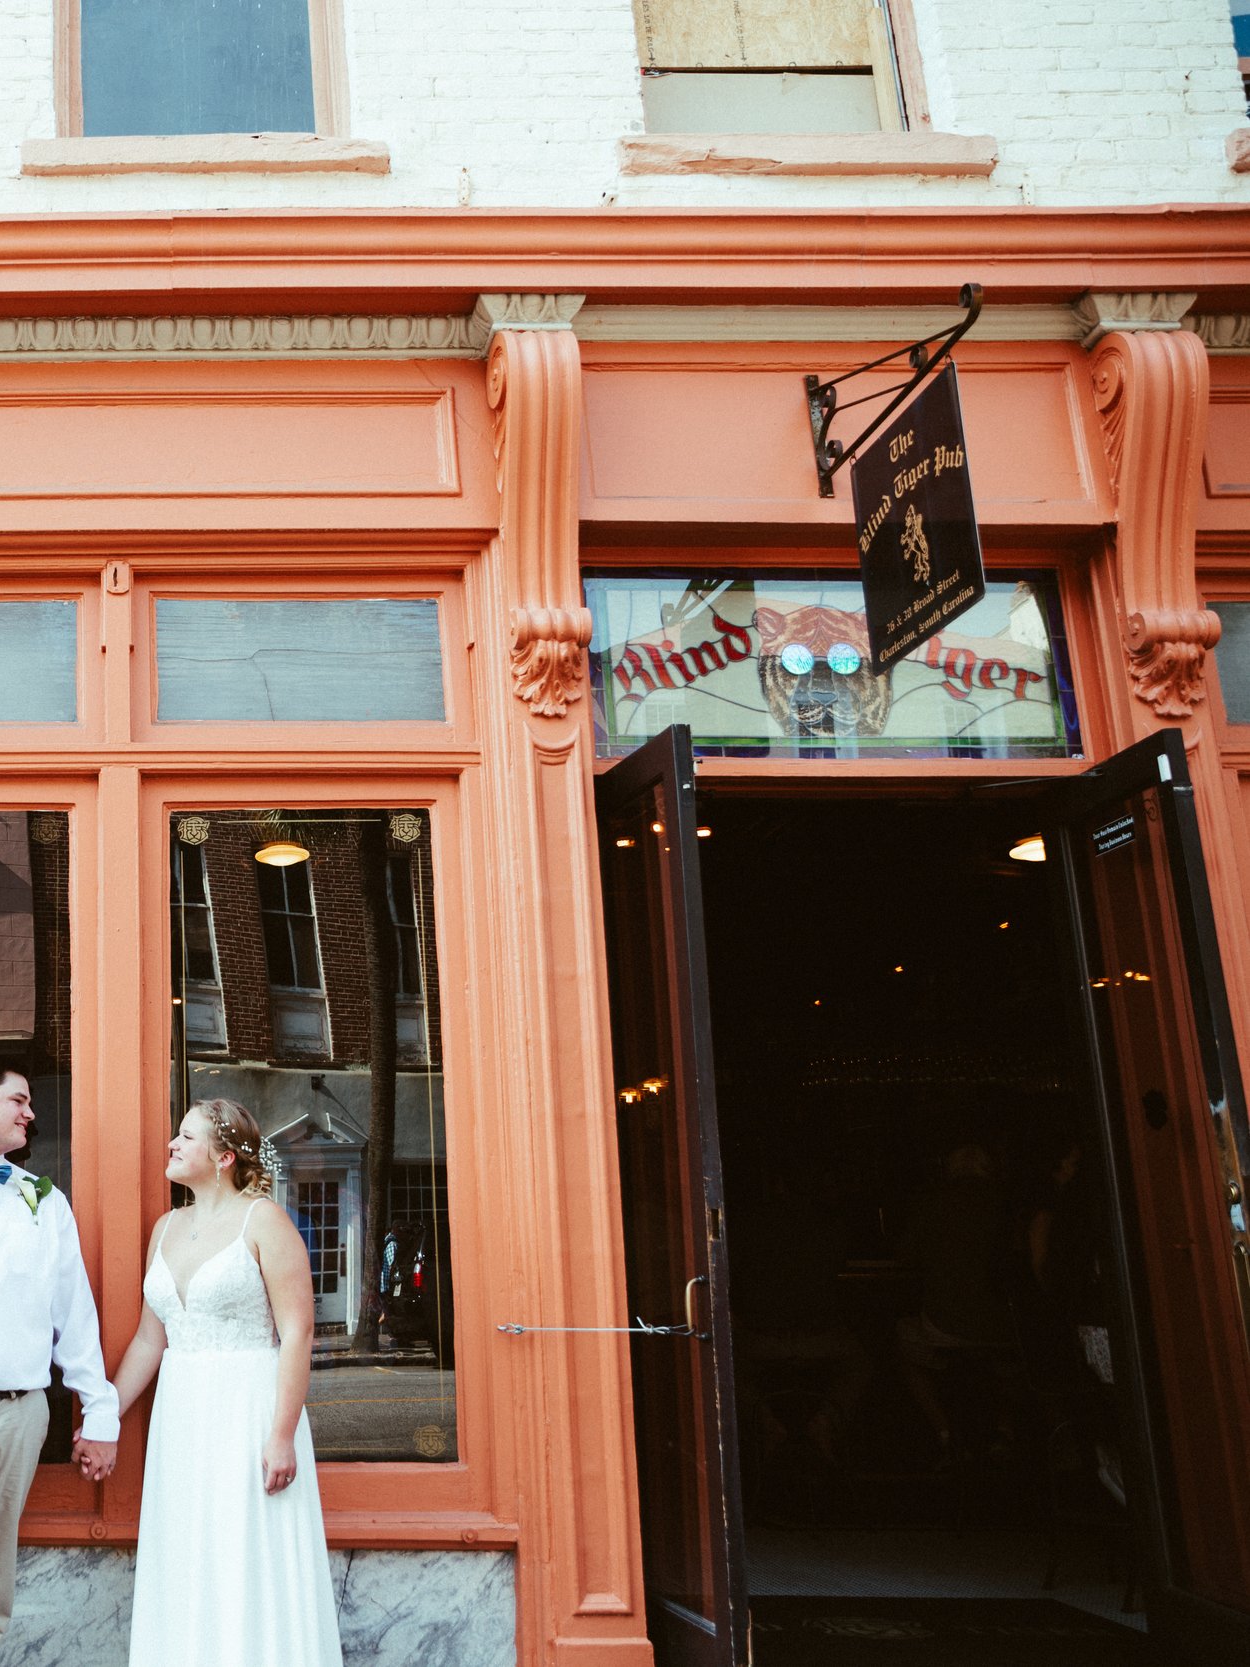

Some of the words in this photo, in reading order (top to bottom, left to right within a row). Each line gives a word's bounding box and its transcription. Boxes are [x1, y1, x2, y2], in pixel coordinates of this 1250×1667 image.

[889, 429, 914, 463] The
[859, 494, 892, 554] Blind
[893, 458, 930, 499] Tiger
[934, 444, 964, 478] Pub
[879, 630, 918, 663] Charleston,
[918, 608, 941, 634] South
[942, 585, 975, 616] Carolina
[903, 605, 912, 621] 38
[913, 588, 935, 613] Broad
[936, 568, 960, 595] Street
[613, 613, 752, 704] Blind
[924, 628, 1042, 700] iger
